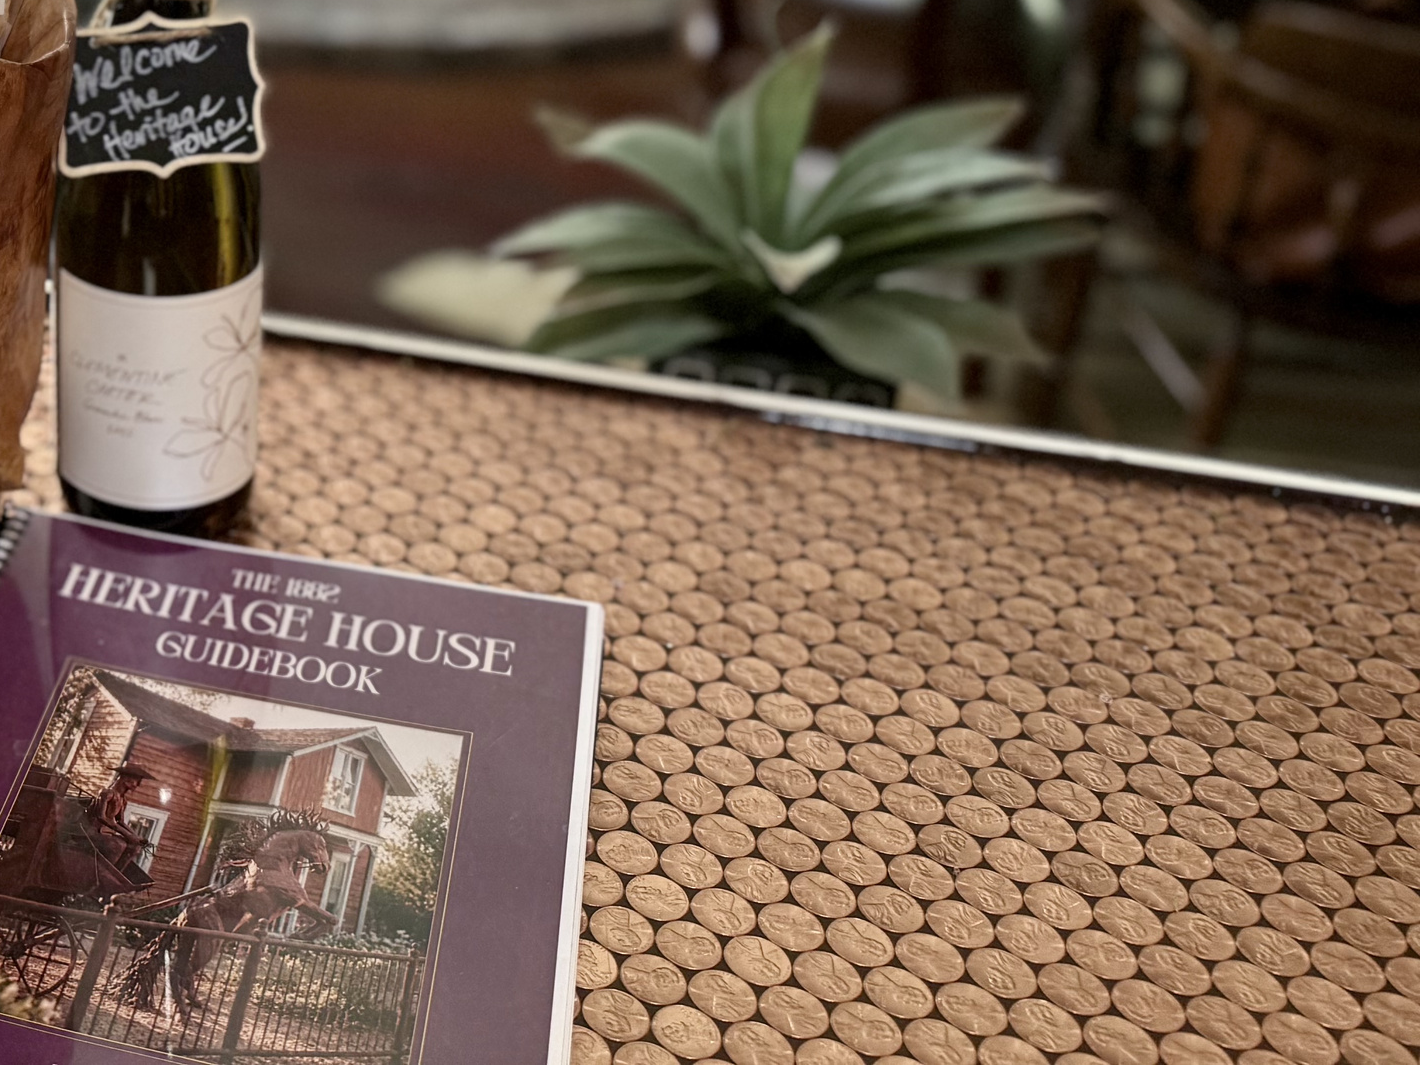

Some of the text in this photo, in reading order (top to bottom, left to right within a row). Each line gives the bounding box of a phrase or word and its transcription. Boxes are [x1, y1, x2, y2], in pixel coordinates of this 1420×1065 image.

[73, 39, 218, 105] Welcome
[67, 88, 180, 144] to the
[103, 95, 226, 162] Heritage
[231, 568, 278, 595] THE
[58, 562, 516, 677] HERITAGE HOUSE
[155, 630, 382, 696] GUIDEBOOK
